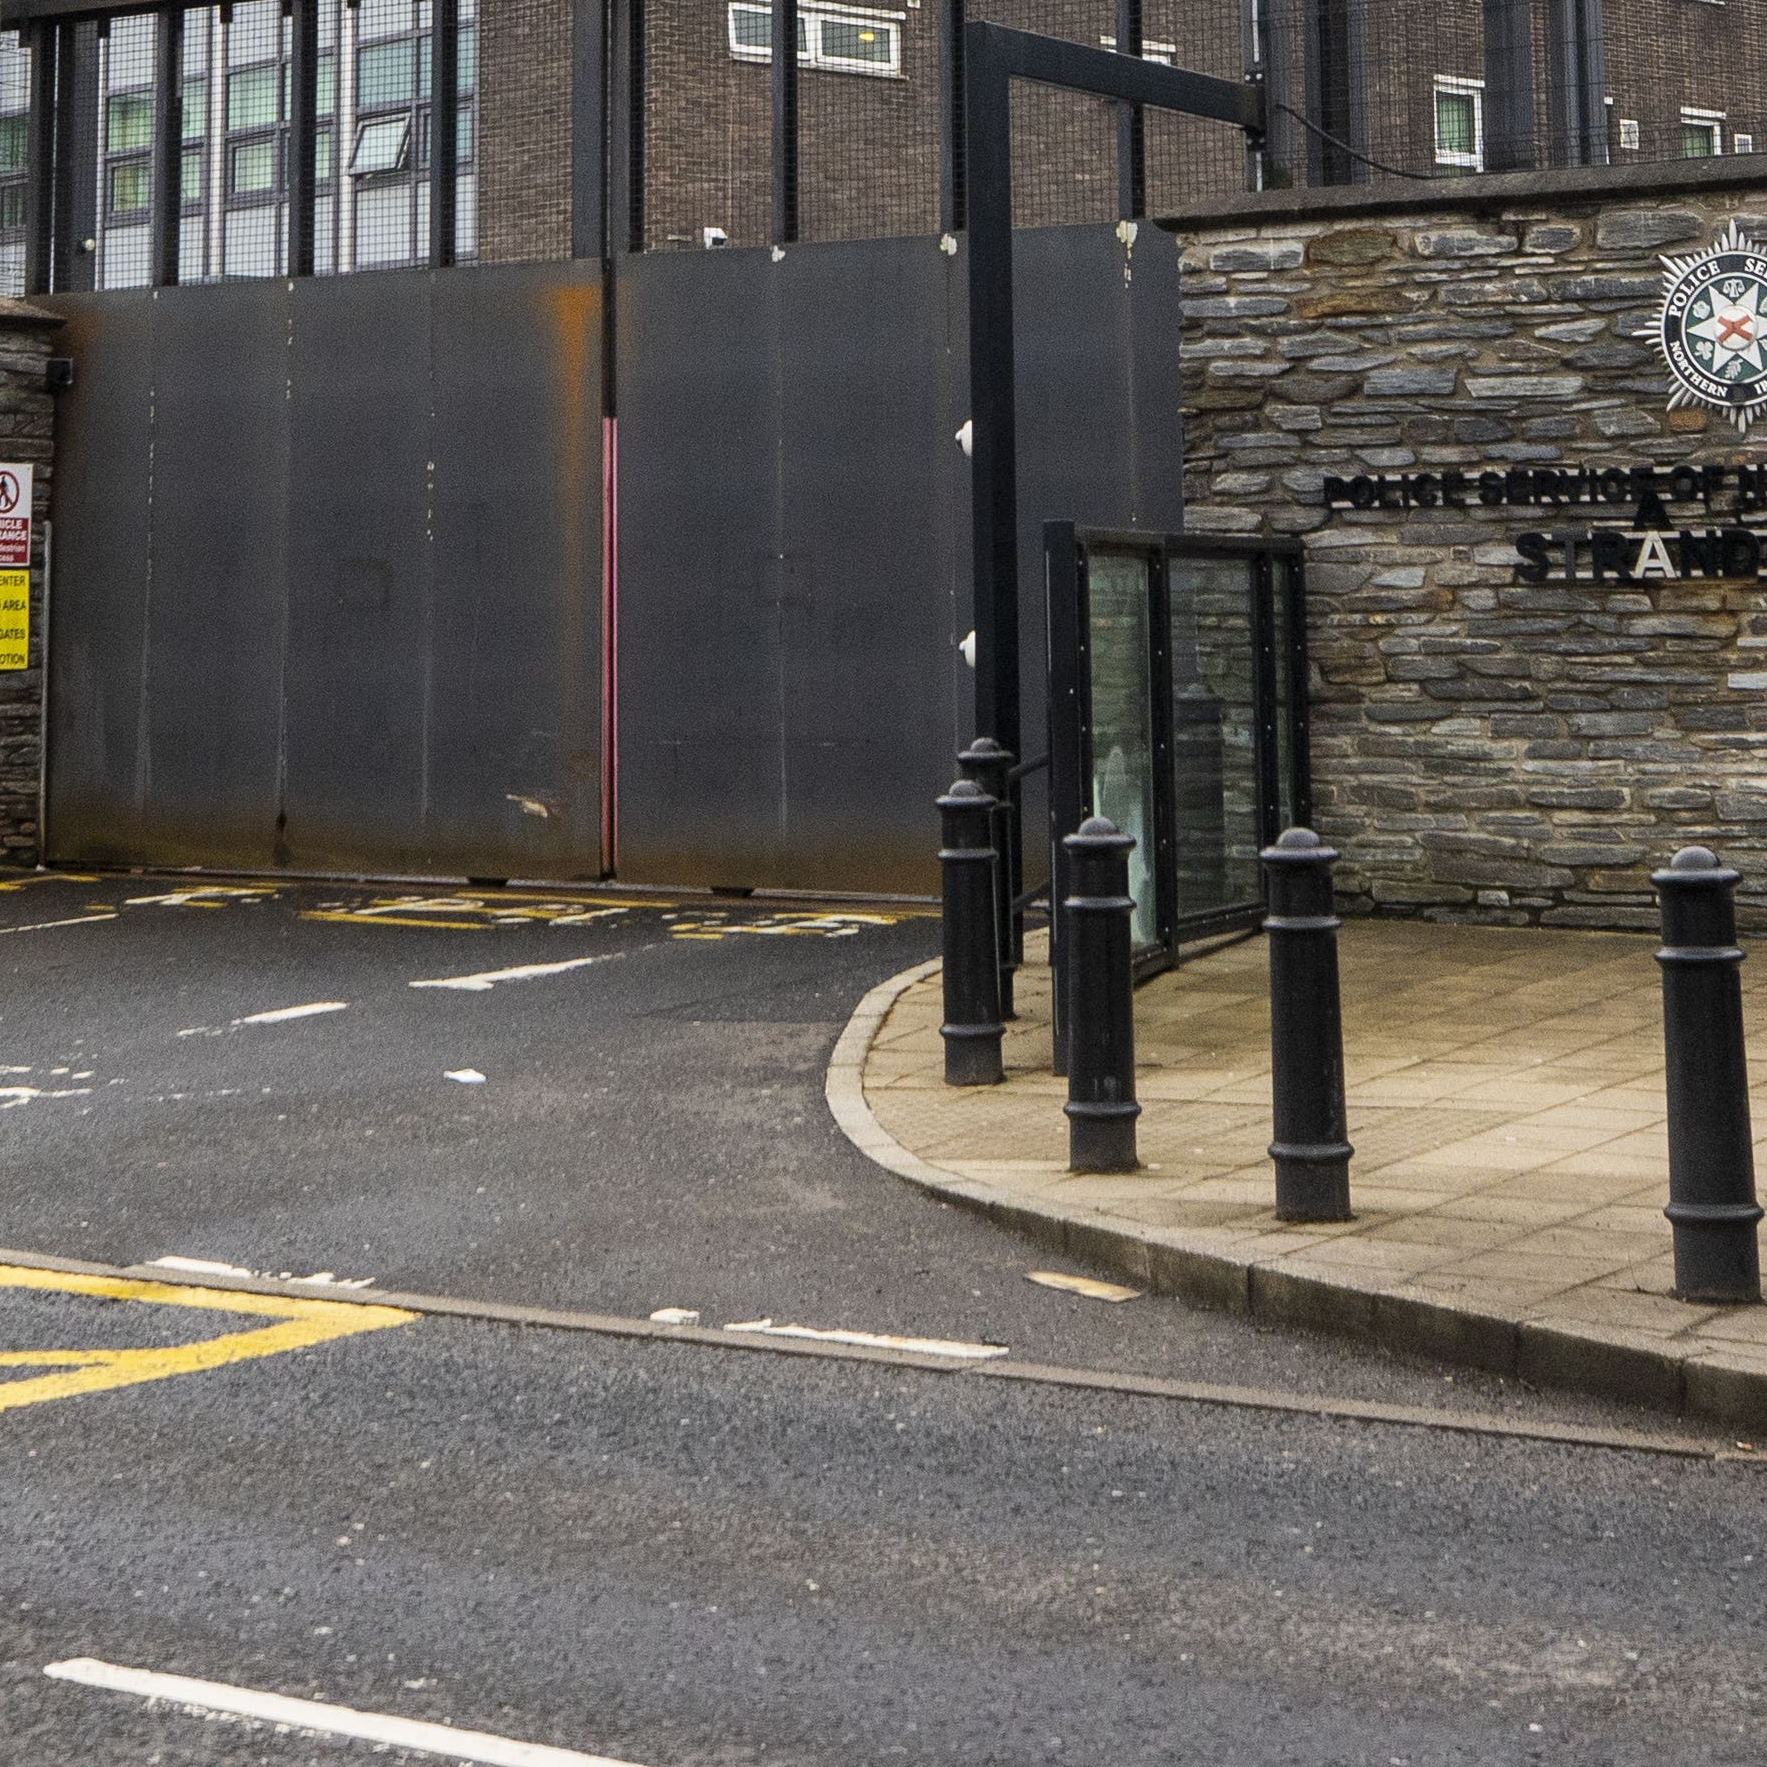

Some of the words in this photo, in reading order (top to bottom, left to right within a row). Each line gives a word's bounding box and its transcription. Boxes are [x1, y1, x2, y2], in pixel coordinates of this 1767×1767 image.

[1668, 260, 1721, 317] POLICE
[1670, 340, 1728, 397] NORTHERN
[1324, 472, 1464, 510] POLICE
[1478, 466, 1654, 506] SERVICE
[1671, 464, 1723, 503] OF
[1515, 527, 1761, 581] STRAND
[3, 599, 26, 611] AREA
